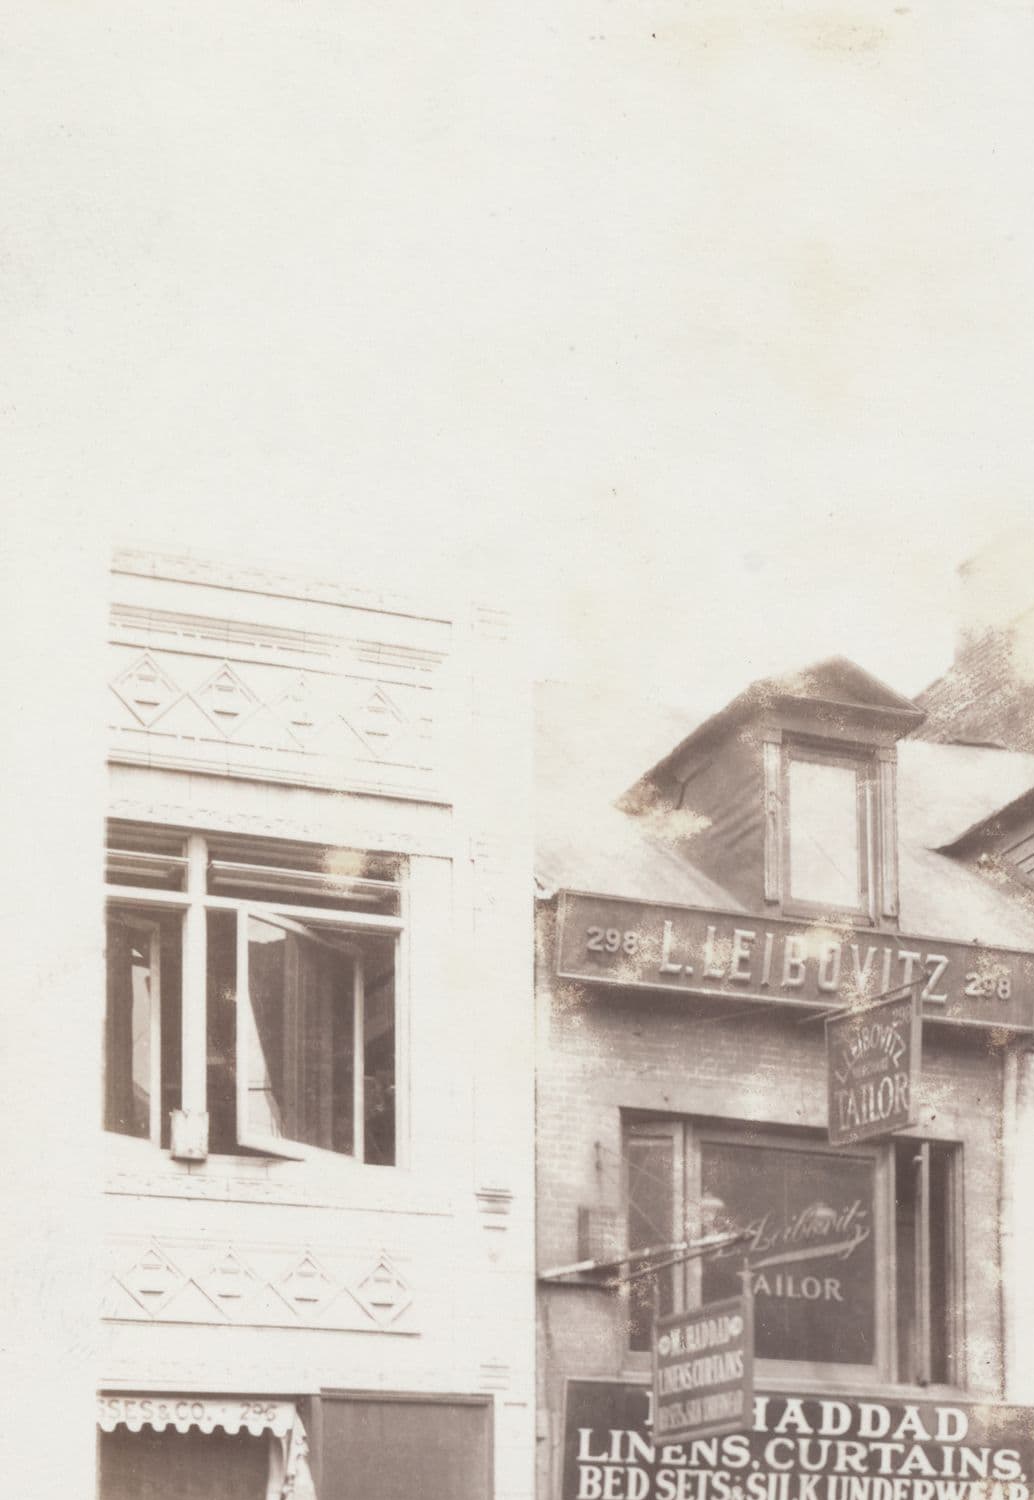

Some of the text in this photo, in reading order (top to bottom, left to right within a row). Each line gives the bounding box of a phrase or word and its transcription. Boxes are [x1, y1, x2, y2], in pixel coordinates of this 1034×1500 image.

[586, 919, 1012, 1003] 298 L. LEIBOVITZ 298
[834, 1071, 911, 1132] TAILOR
